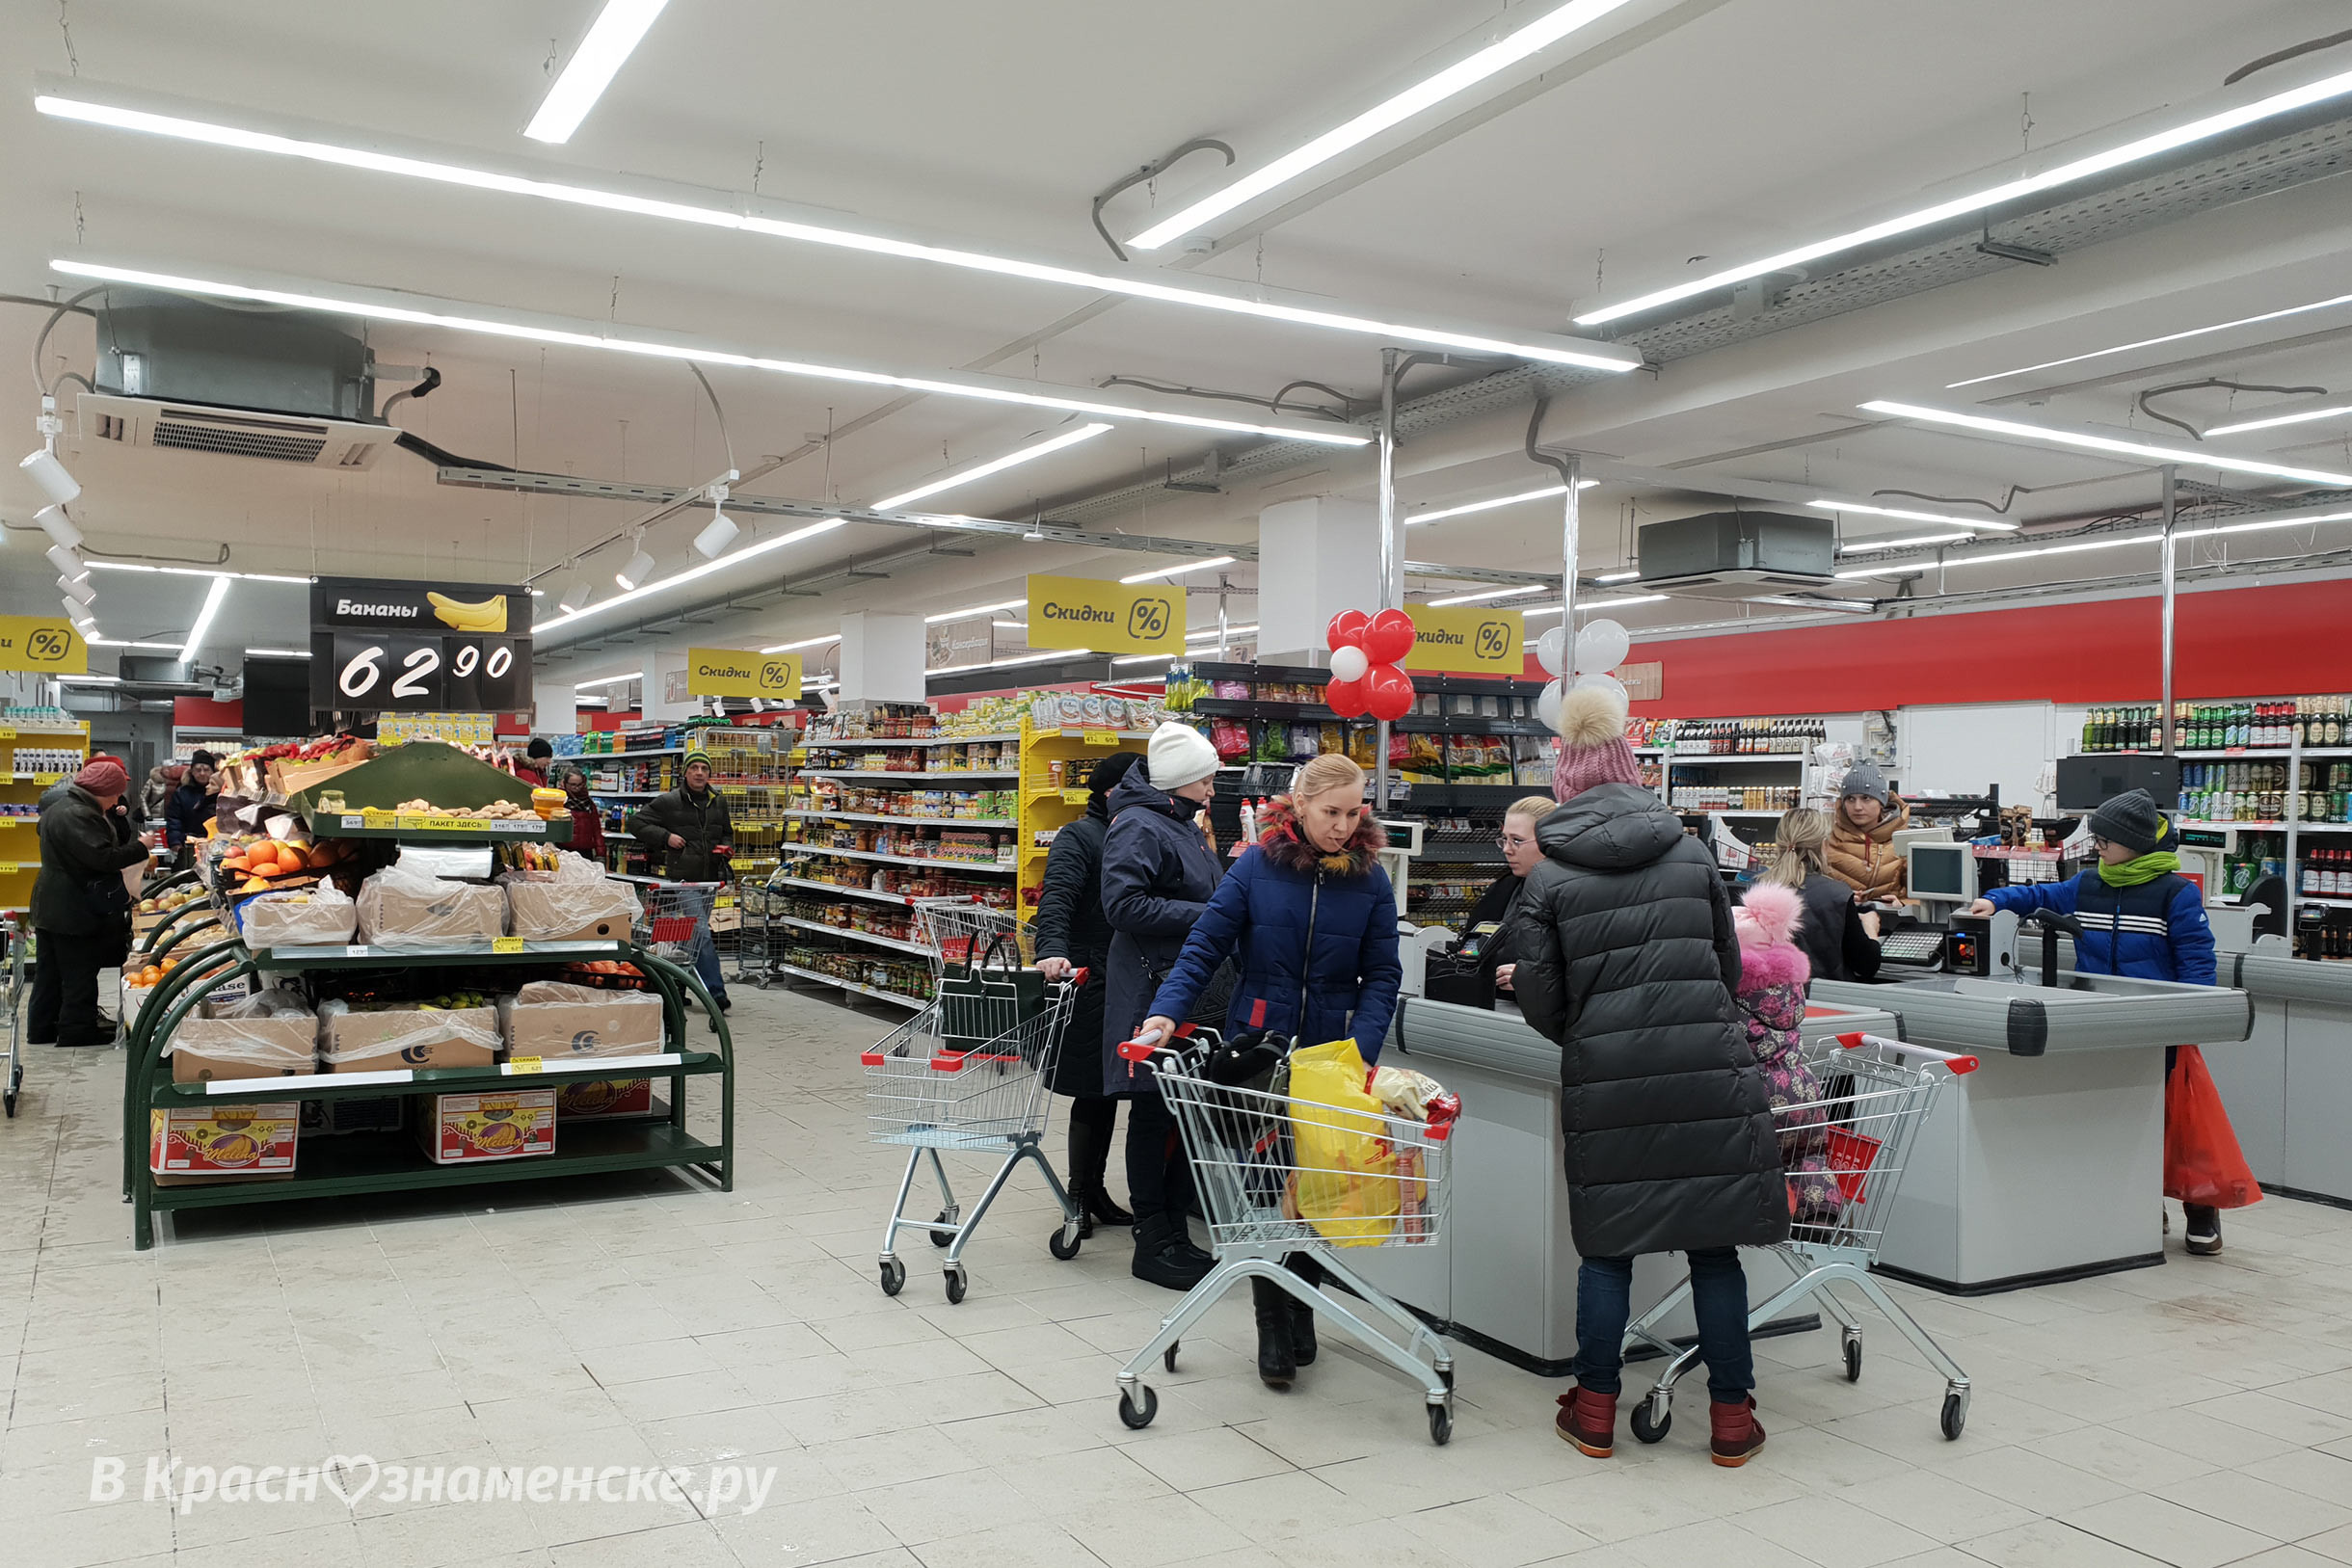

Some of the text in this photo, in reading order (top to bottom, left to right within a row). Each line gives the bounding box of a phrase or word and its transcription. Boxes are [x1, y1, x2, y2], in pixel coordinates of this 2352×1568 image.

[335, 598, 418, 618] Бананы
[1042, 601, 1115, 624] Скидки
[1415, 628, 1465, 645] кидки
[698, 664, 752, 678] Скидки
[213, 980, 246, 992] ase
[474, 1133, 522, 1148] Melina
[202, 1148, 256, 1161] Melina
